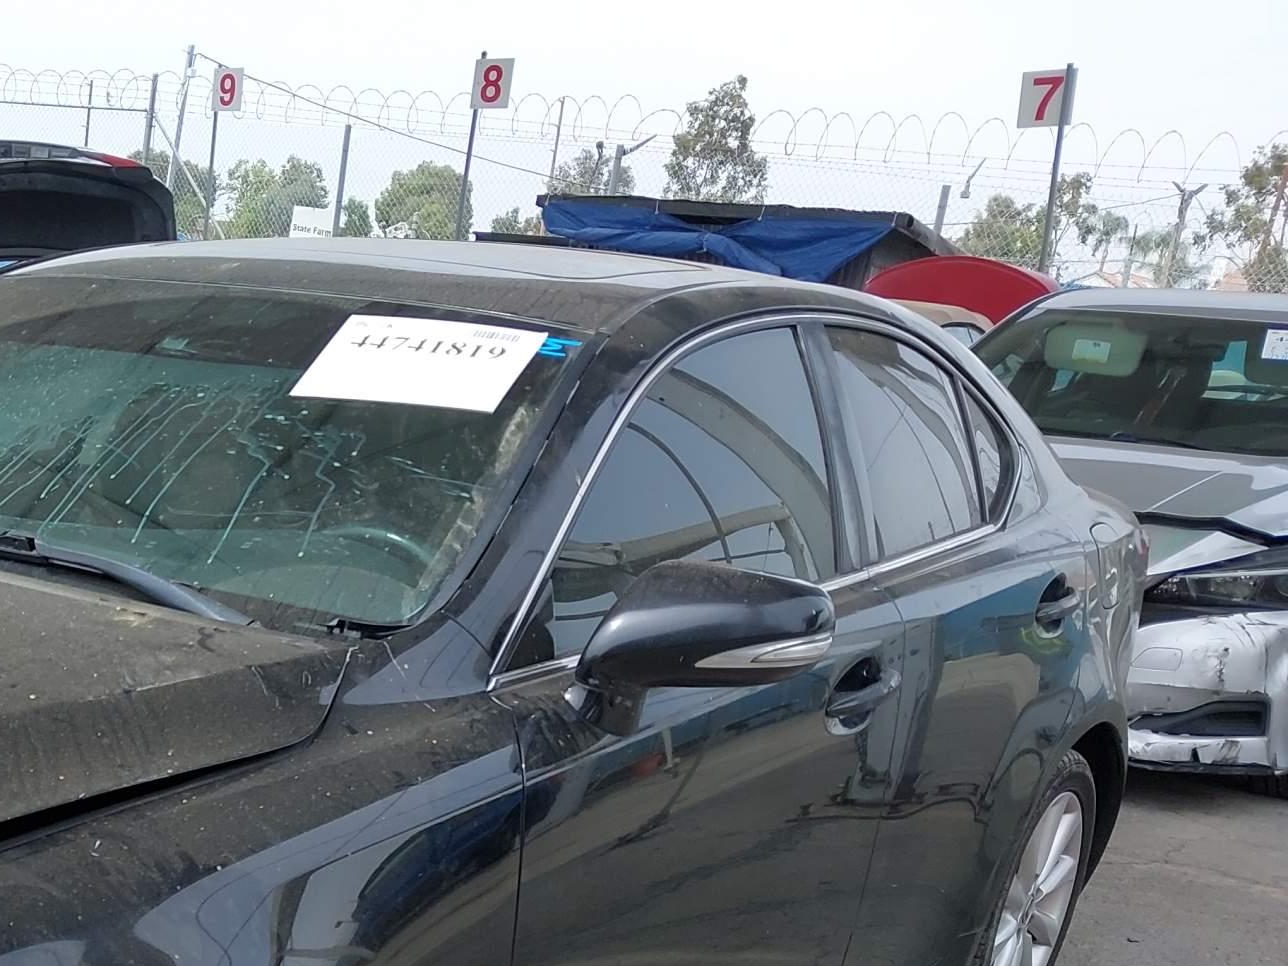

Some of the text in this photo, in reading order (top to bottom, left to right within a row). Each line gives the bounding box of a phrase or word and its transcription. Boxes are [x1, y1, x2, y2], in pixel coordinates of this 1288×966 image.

[219, 73, 236, 107] 9
[480, 64, 504, 103] 8
[1033, 75, 1065, 121] 7
[292, 223, 332, 238] State Farm
[350, 334, 507, 360] 44741819
